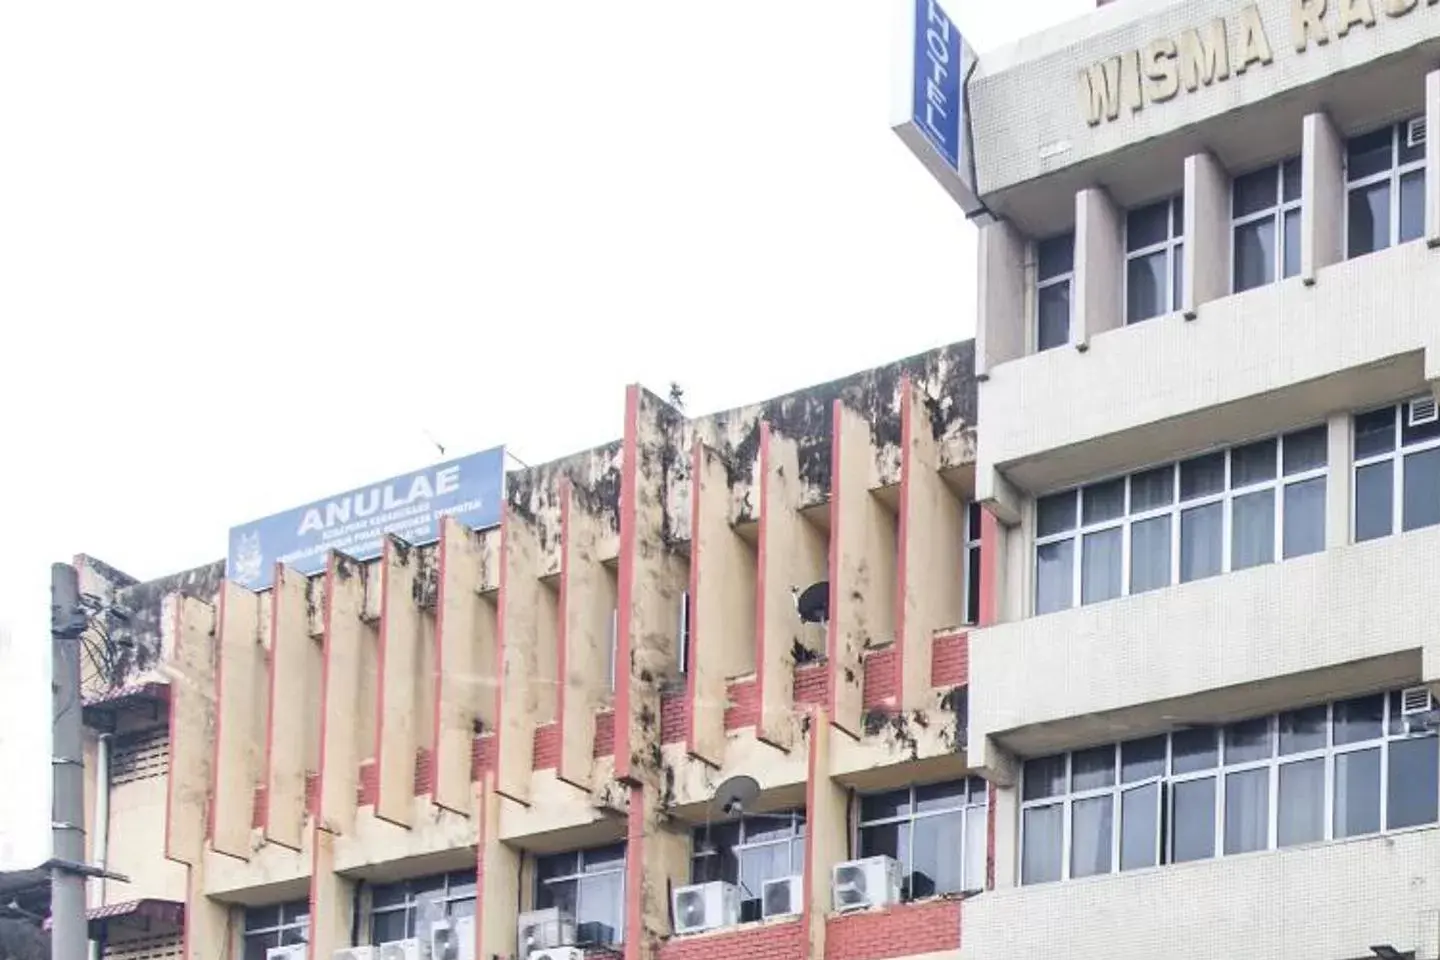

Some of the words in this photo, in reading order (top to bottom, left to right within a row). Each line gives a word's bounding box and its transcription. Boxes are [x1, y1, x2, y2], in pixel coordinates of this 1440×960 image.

[926, 0, 950, 143] HOTEL
[1078, 3, 1273, 127] WISMA
[1292, 0, 1440, 53] RA
[297, 464, 461, 536] ANULAE
